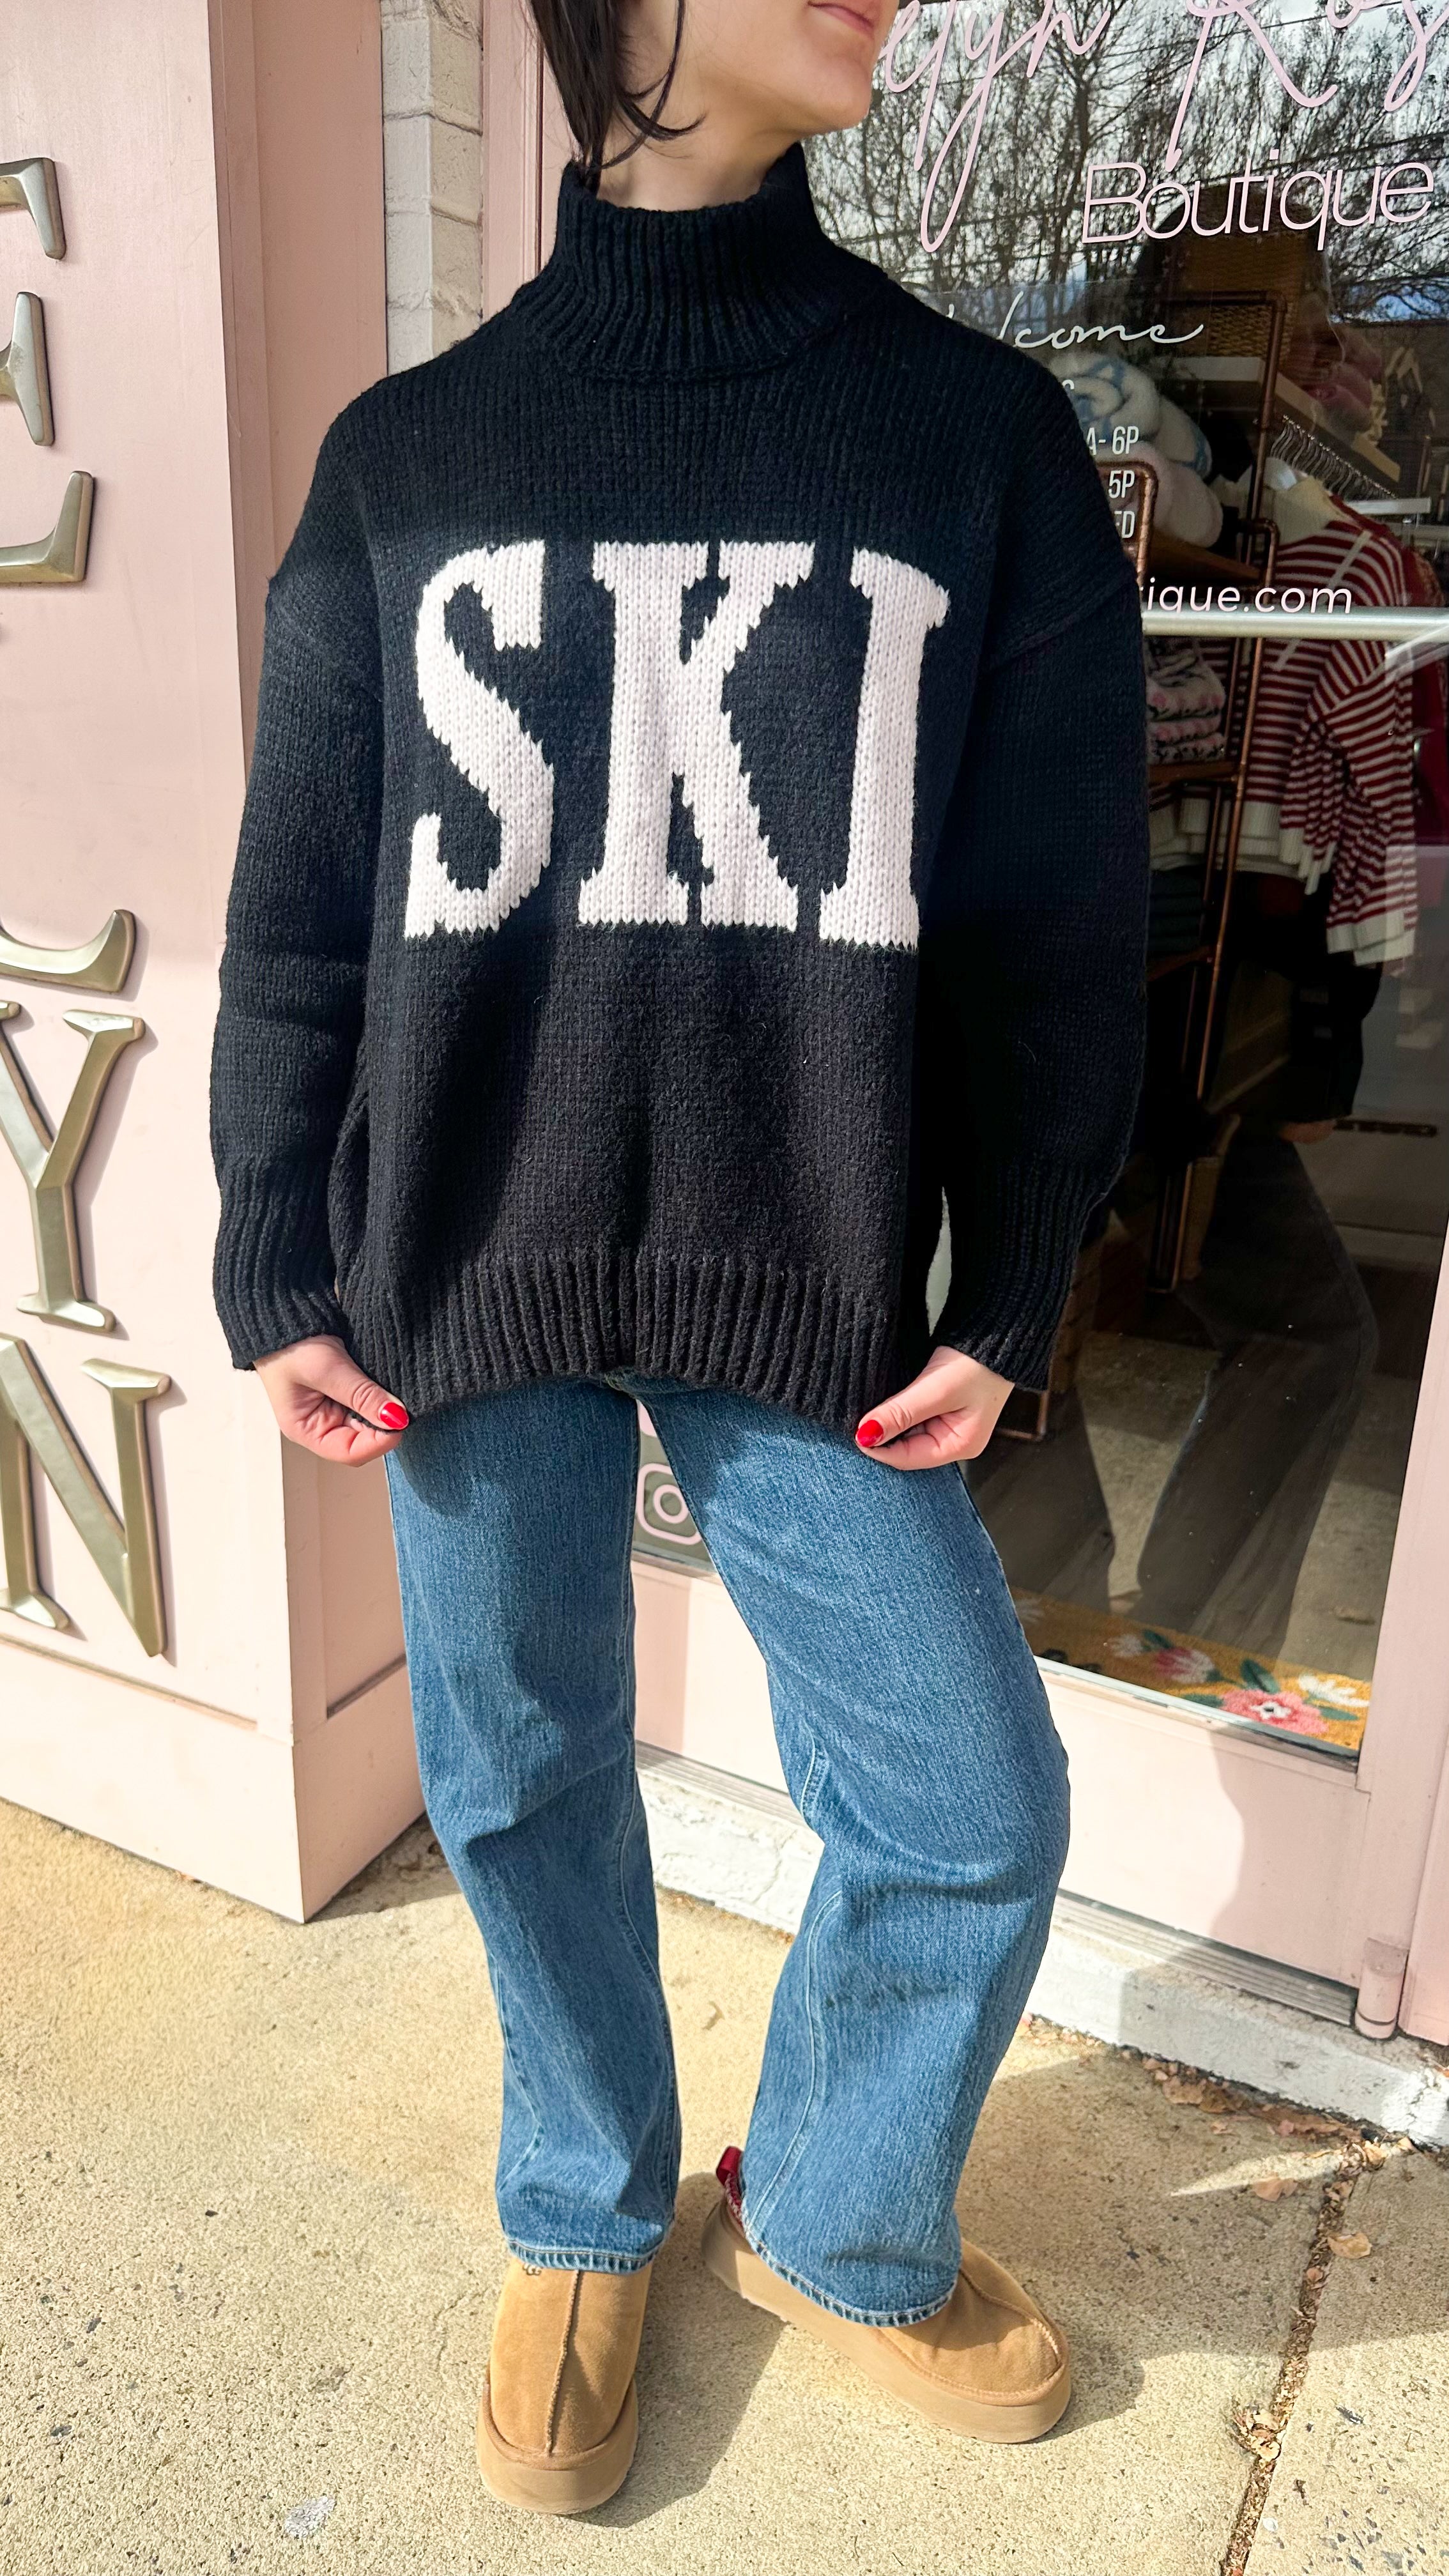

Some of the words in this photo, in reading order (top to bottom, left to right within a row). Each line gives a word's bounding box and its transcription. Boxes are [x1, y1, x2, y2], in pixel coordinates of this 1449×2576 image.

[1082, 148, 1434, 251] Boutique
[948, 291, 1204, 349] lcome
[1112, 425, 1139, 455] 6P
[1108, 470, 1135, 499] 5P
[1140, 577, 1352, 614] ique.com
[404, 540, 949, 951] SKI
